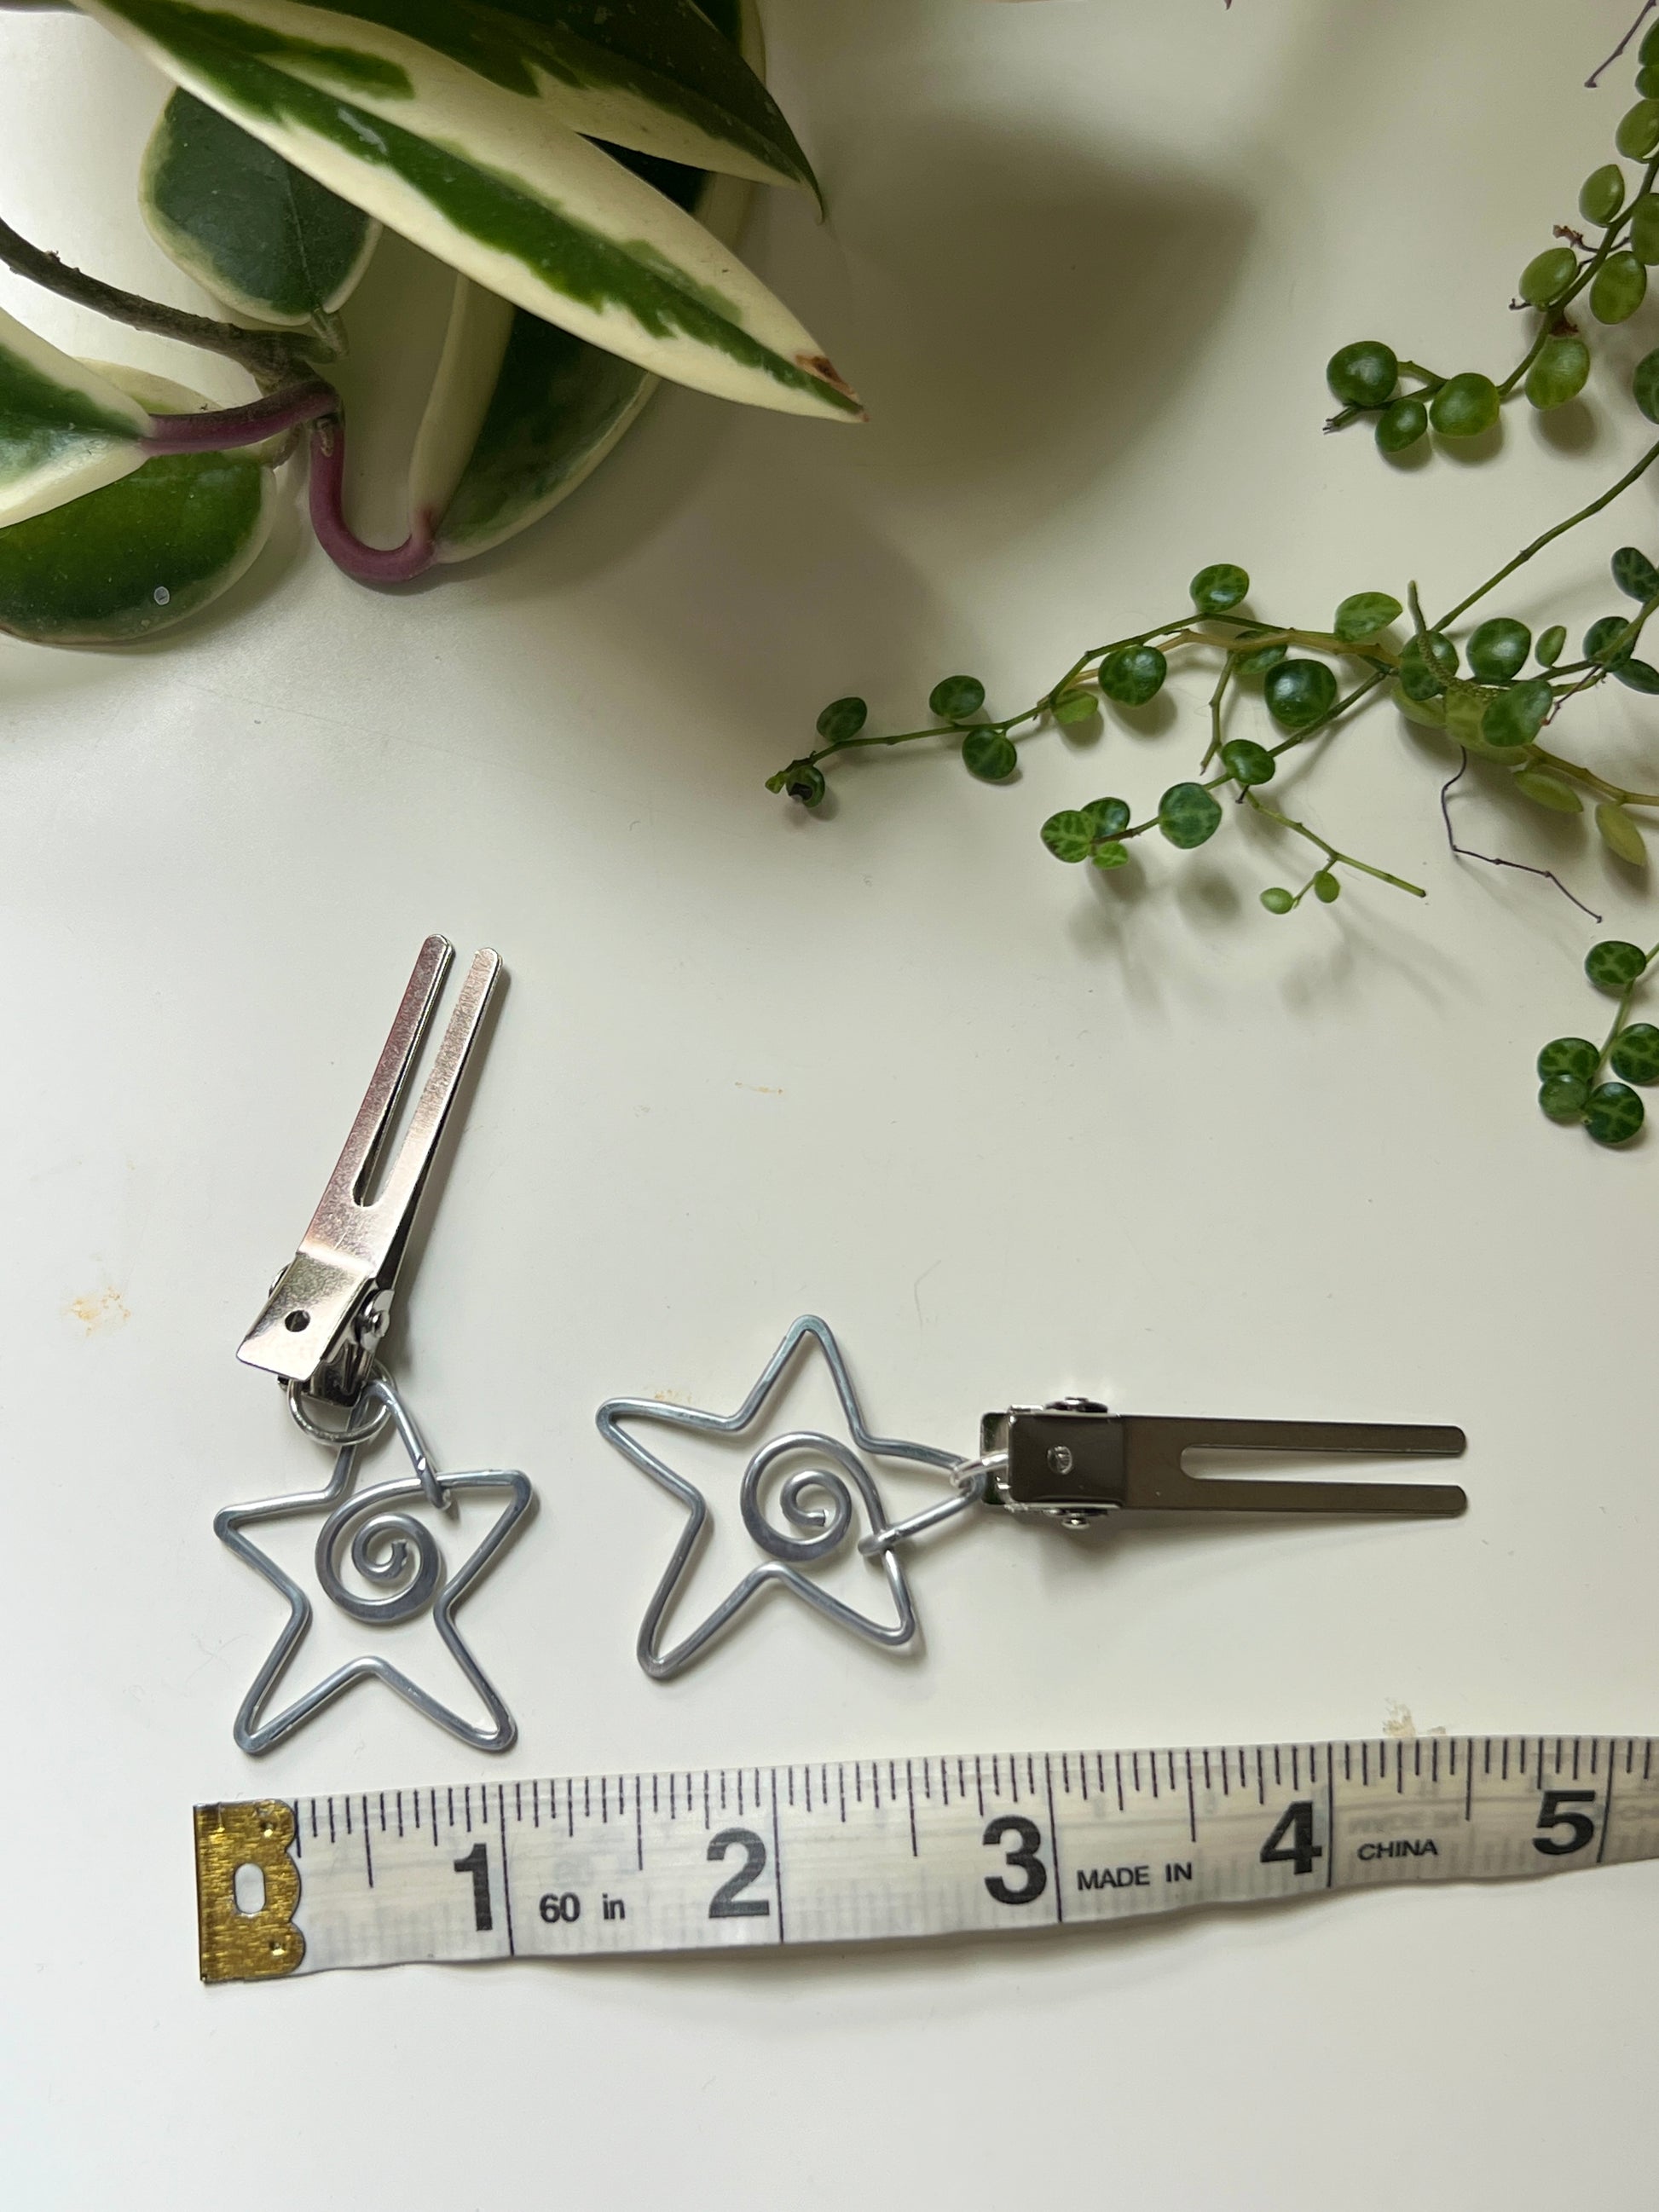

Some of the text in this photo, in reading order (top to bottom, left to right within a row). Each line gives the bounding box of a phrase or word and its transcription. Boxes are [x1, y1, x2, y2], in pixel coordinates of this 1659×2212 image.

[982, 1815, 1047, 1905] 3
[1260, 1800, 1322, 1874] 4
[1532, 1790, 1596, 1856] 5
[454, 1843, 494, 1931] 1
[707, 1828, 770, 1918] 2
[1078, 1839, 1439, 1891] MADE IN CHINA
[539, 1892, 626, 1924] 60 in
